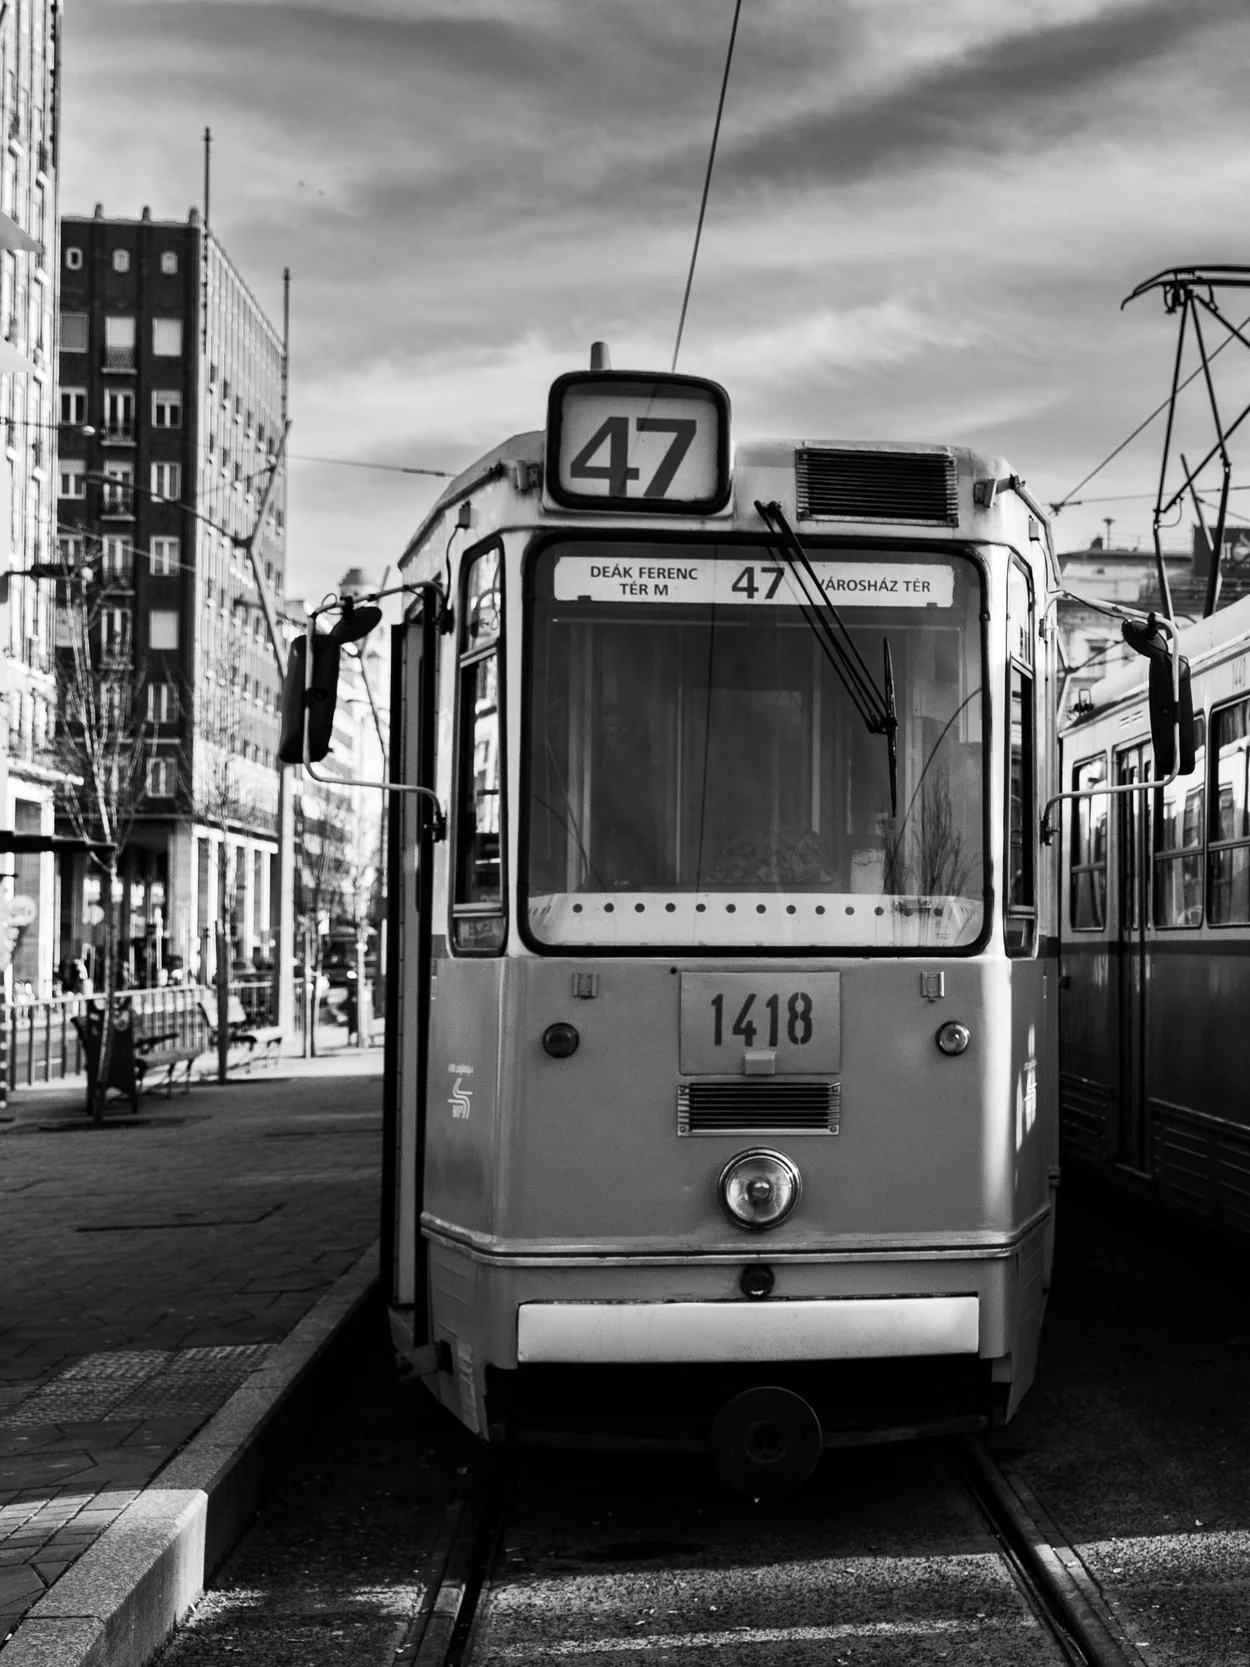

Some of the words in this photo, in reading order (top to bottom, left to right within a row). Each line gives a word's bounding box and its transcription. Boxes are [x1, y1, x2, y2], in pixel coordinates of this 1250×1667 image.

[569, 415, 697, 498] 47
[590, 563, 633, 579] DEÁK
[639, 566, 698, 580] FERENC
[731, 566, 786, 601] 47
[619, 581, 648, 596] TÉR
[654, 584, 669, 597] M
[903, 578, 931, 593] TÉR
[710, 991, 813, 1048] 1418
